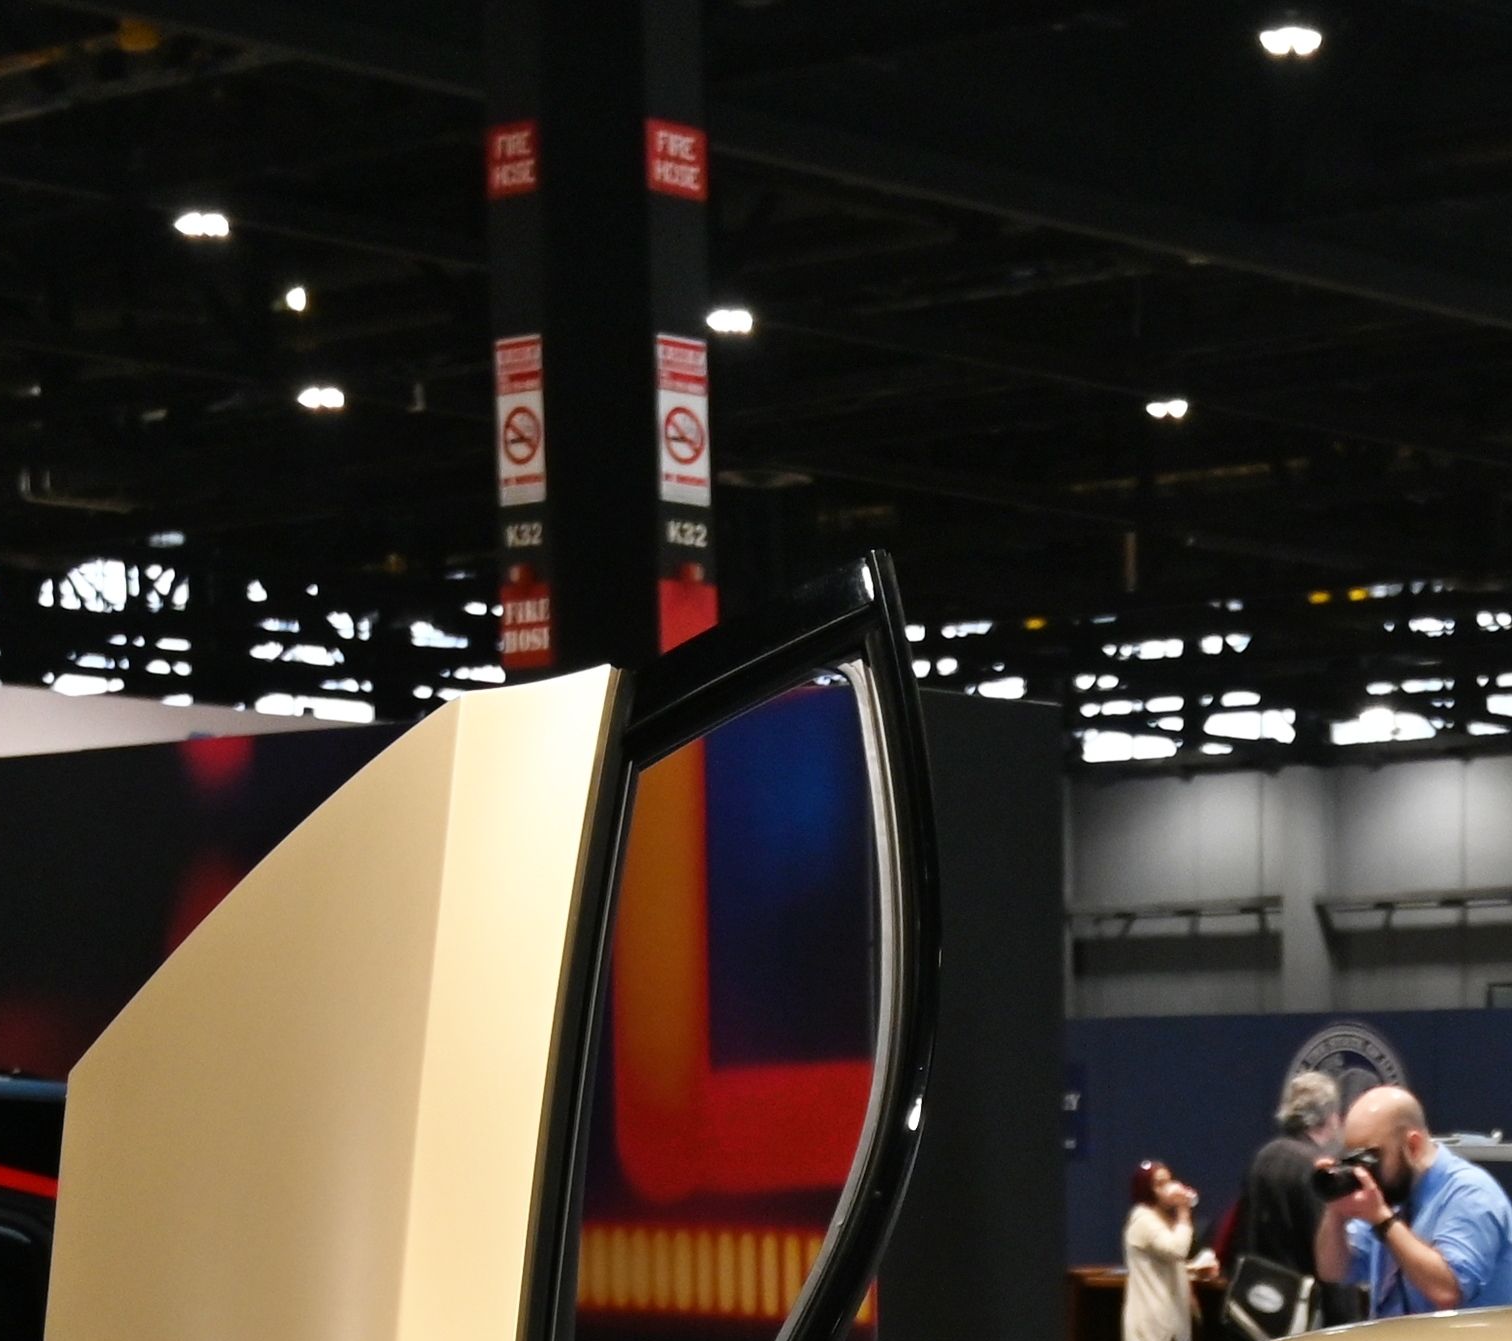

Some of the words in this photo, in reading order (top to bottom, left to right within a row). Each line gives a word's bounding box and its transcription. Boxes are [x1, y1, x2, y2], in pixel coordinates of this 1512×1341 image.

[657, 130, 696, 161] FIRE
[654, 160, 701, 191] HOSE
[506, 523, 543, 547] K32
[667, 520, 708, 547] K32
